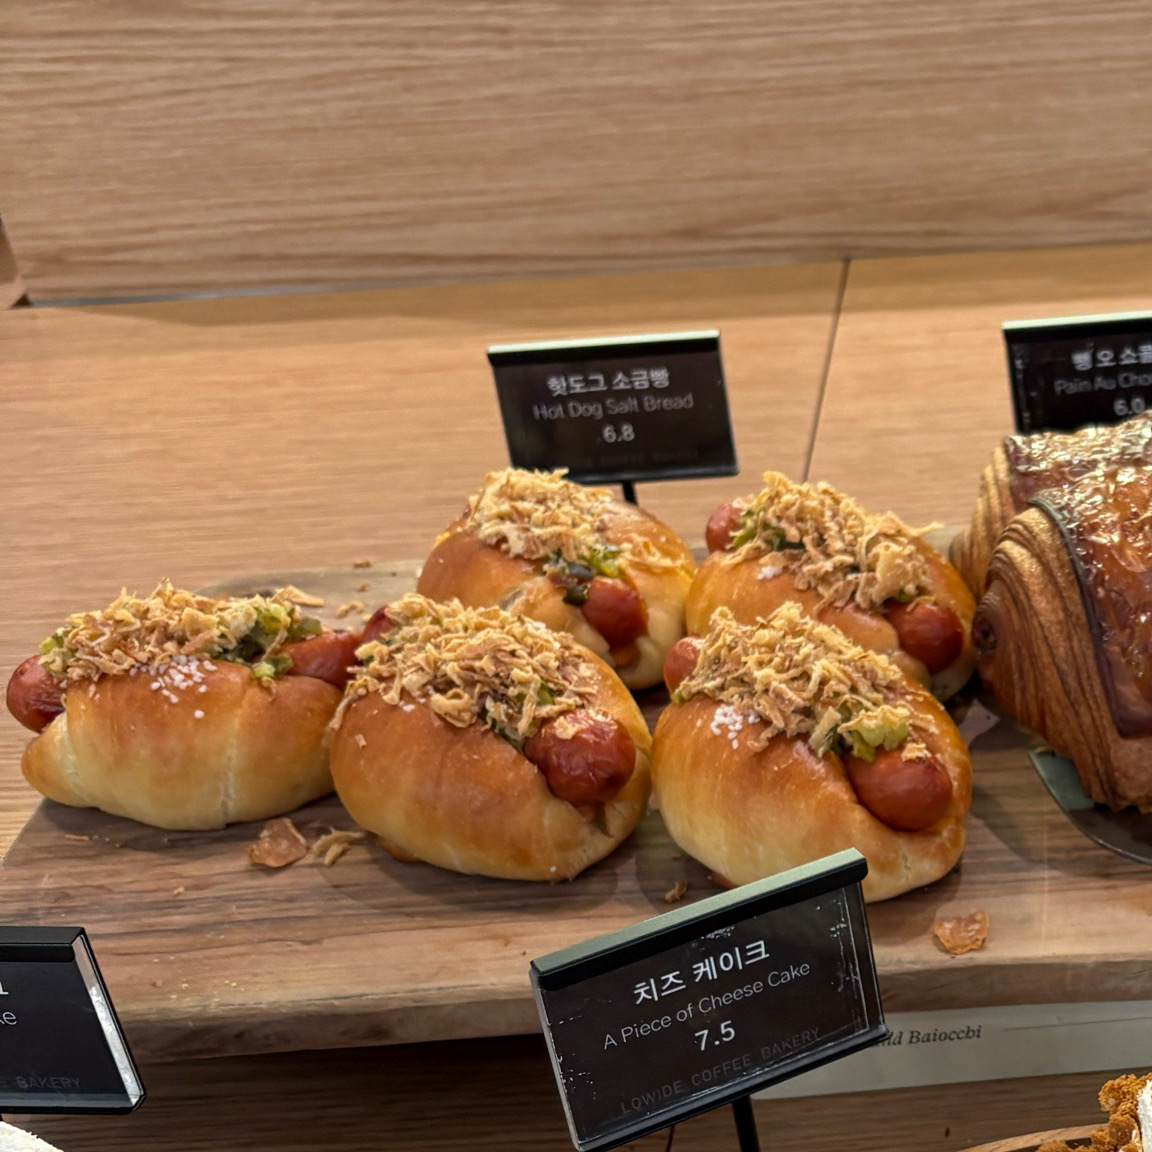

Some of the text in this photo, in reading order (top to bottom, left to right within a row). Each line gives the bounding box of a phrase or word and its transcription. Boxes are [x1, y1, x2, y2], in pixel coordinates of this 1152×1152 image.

[1096, 350, 1116, 367] 오
[547, 366, 670, 396] 핫도그 소금빵
[532, 392, 695, 420] Hot Dog Salt Bread
[1113, 397, 1146, 416] 6.0
[602, 422, 636, 443] 6.8
[633, 940, 770, 1005] 치즈 케이크
[603, 962, 812, 1051] A Piece of Cheese Cake
[694, 1020, 737, 1052] 7.5
[909, 1025, 982, 1045] Baiocchi
[16, 1076, 81, 1089] BAKERY
[621, 1026, 822, 1116] LOWIDE COFFEE BAKERY
